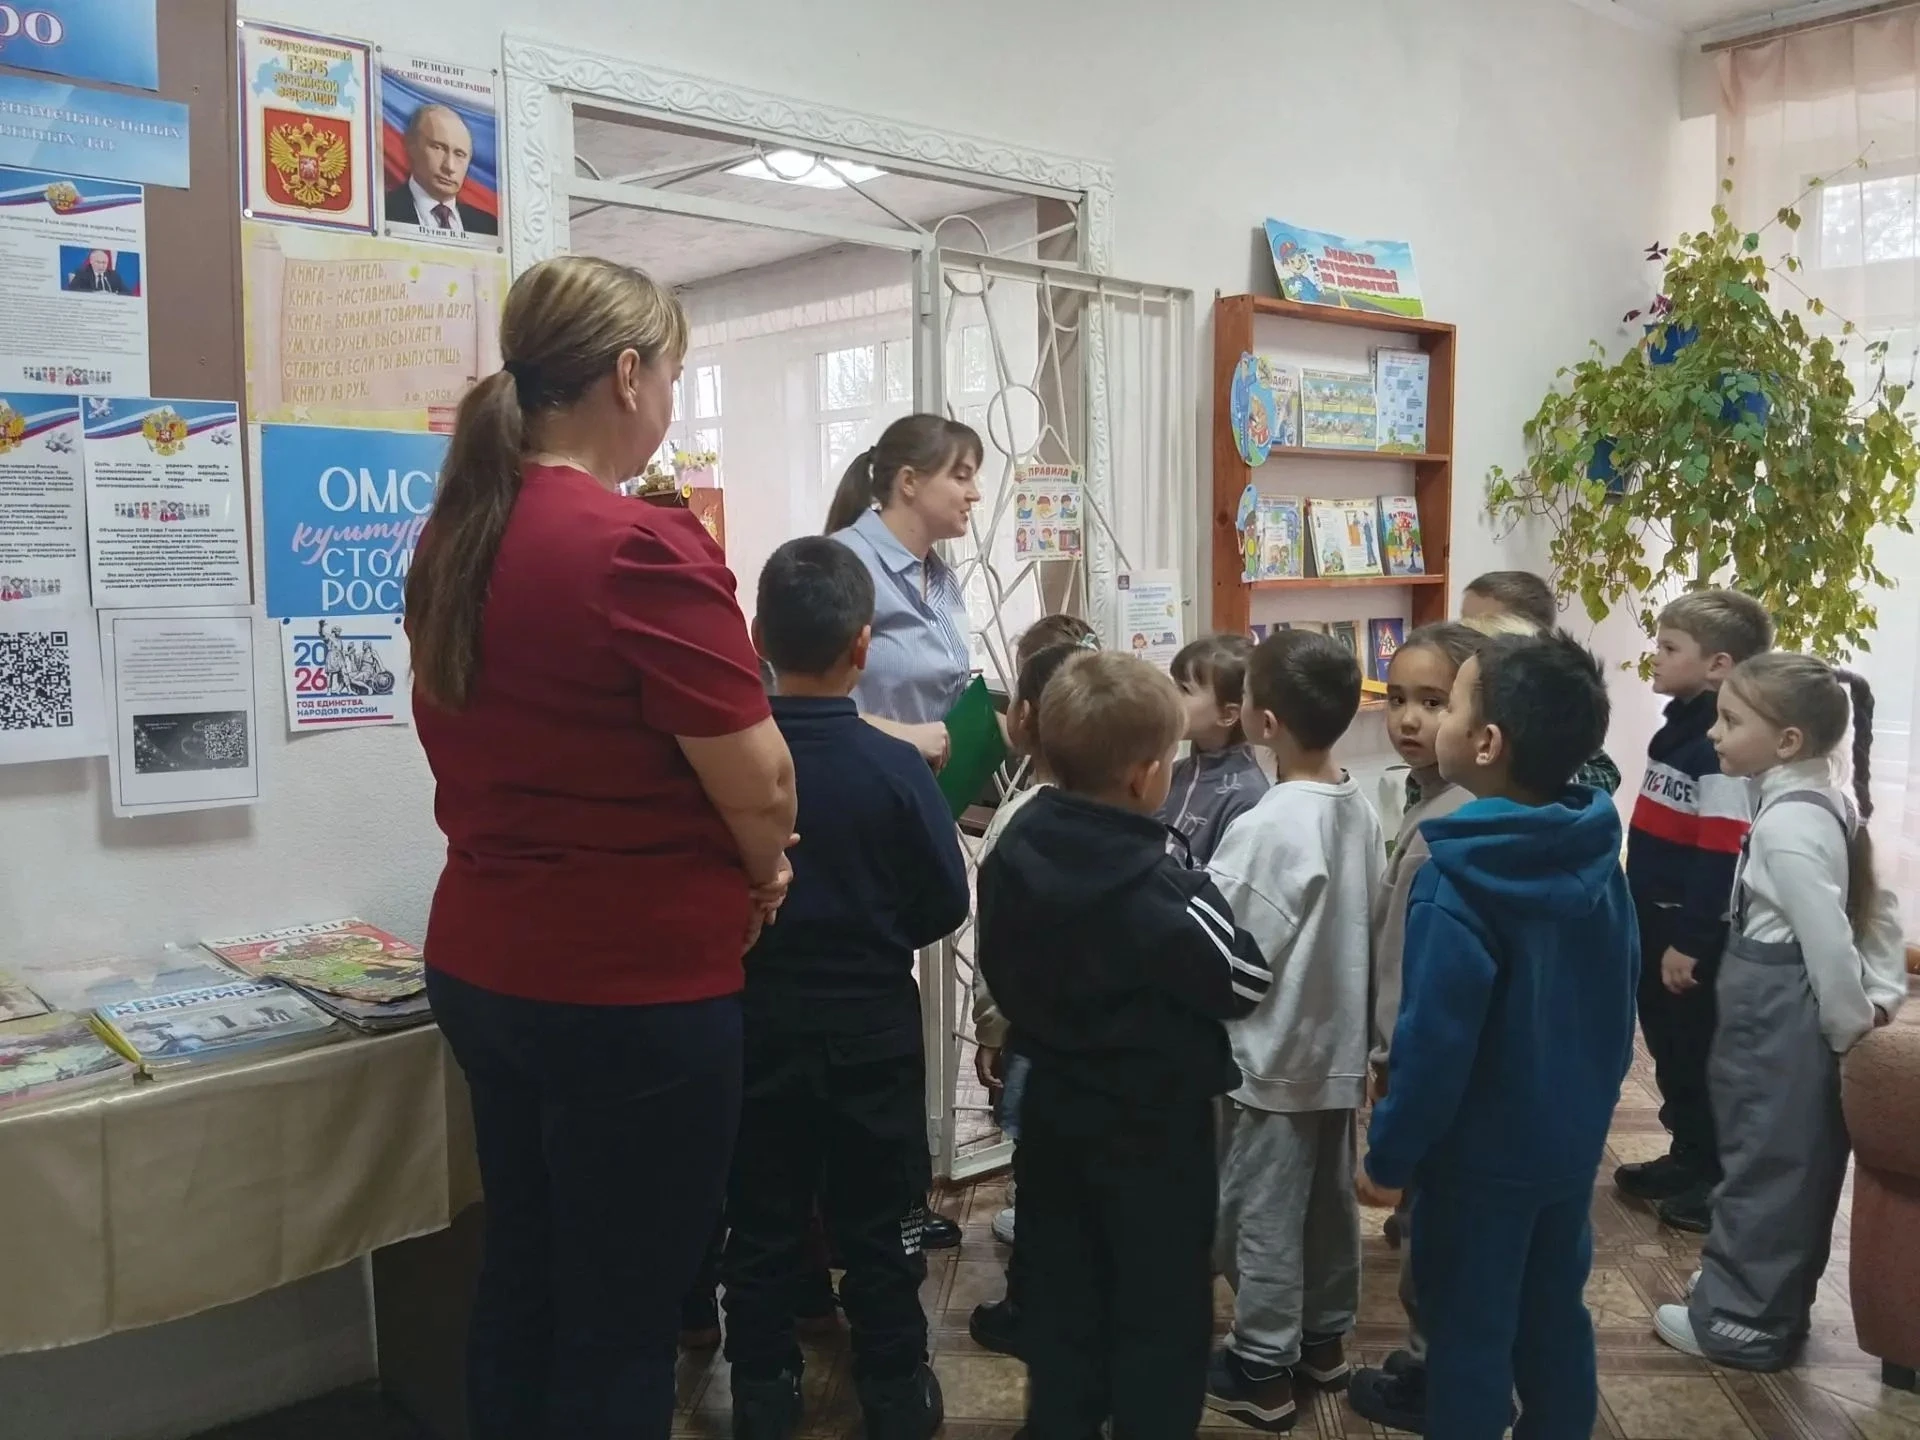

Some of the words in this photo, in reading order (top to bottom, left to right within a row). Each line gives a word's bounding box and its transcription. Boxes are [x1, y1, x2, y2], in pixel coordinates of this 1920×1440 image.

[289, 55, 329, 78] ГЕРБ
[412, 59, 465, 77] ПРЕЗИДЕНТ
[443, 80, 491, 94] ФЕДЕРАЦИИ
[418, 226, 447, 237] Путин
[450, 230, 459, 238] В.
[290, 264, 325, 281] КНИГА
[288, 286, 323, 306] КНИГА
[287, 311, 323, 330] КНИГА
[335, 307, 382, 328] БЛИЗКИЙ
[384, 304, 436, 324] ТОВАРИЩ
[437, 304, 444, 318] И
[309, 336, 330, 351] КАК
[375, 326, 431, 349] ВЫСЫХАЕТ
[435, 326, 443, 338] И
[347, 356, 376, 375] ЕСЛИ
[378, 355, 393, 371] ТЫ
[396, 347, 462, 370] ВЫПУСТИШЬ
[292, 384, 327, 403] КНИГУ
[331, 384, 343, 399] ИЗ
[1028, 466, 1069, 477] ПРАВИЛА
[318, 465, 440, 514] ОМС
[321, 579, 406, 611] РОС
[293, 641, 328, 667] 20
[294, 667, 327, 692] 26
[296, 701, 315, 709] ГОД
[316, 699, 363, 708] ЕДИНСТВА
[297, 708, 339, 716] НАРОДОВ
[341, 706, 378, 715] РОССИИ
